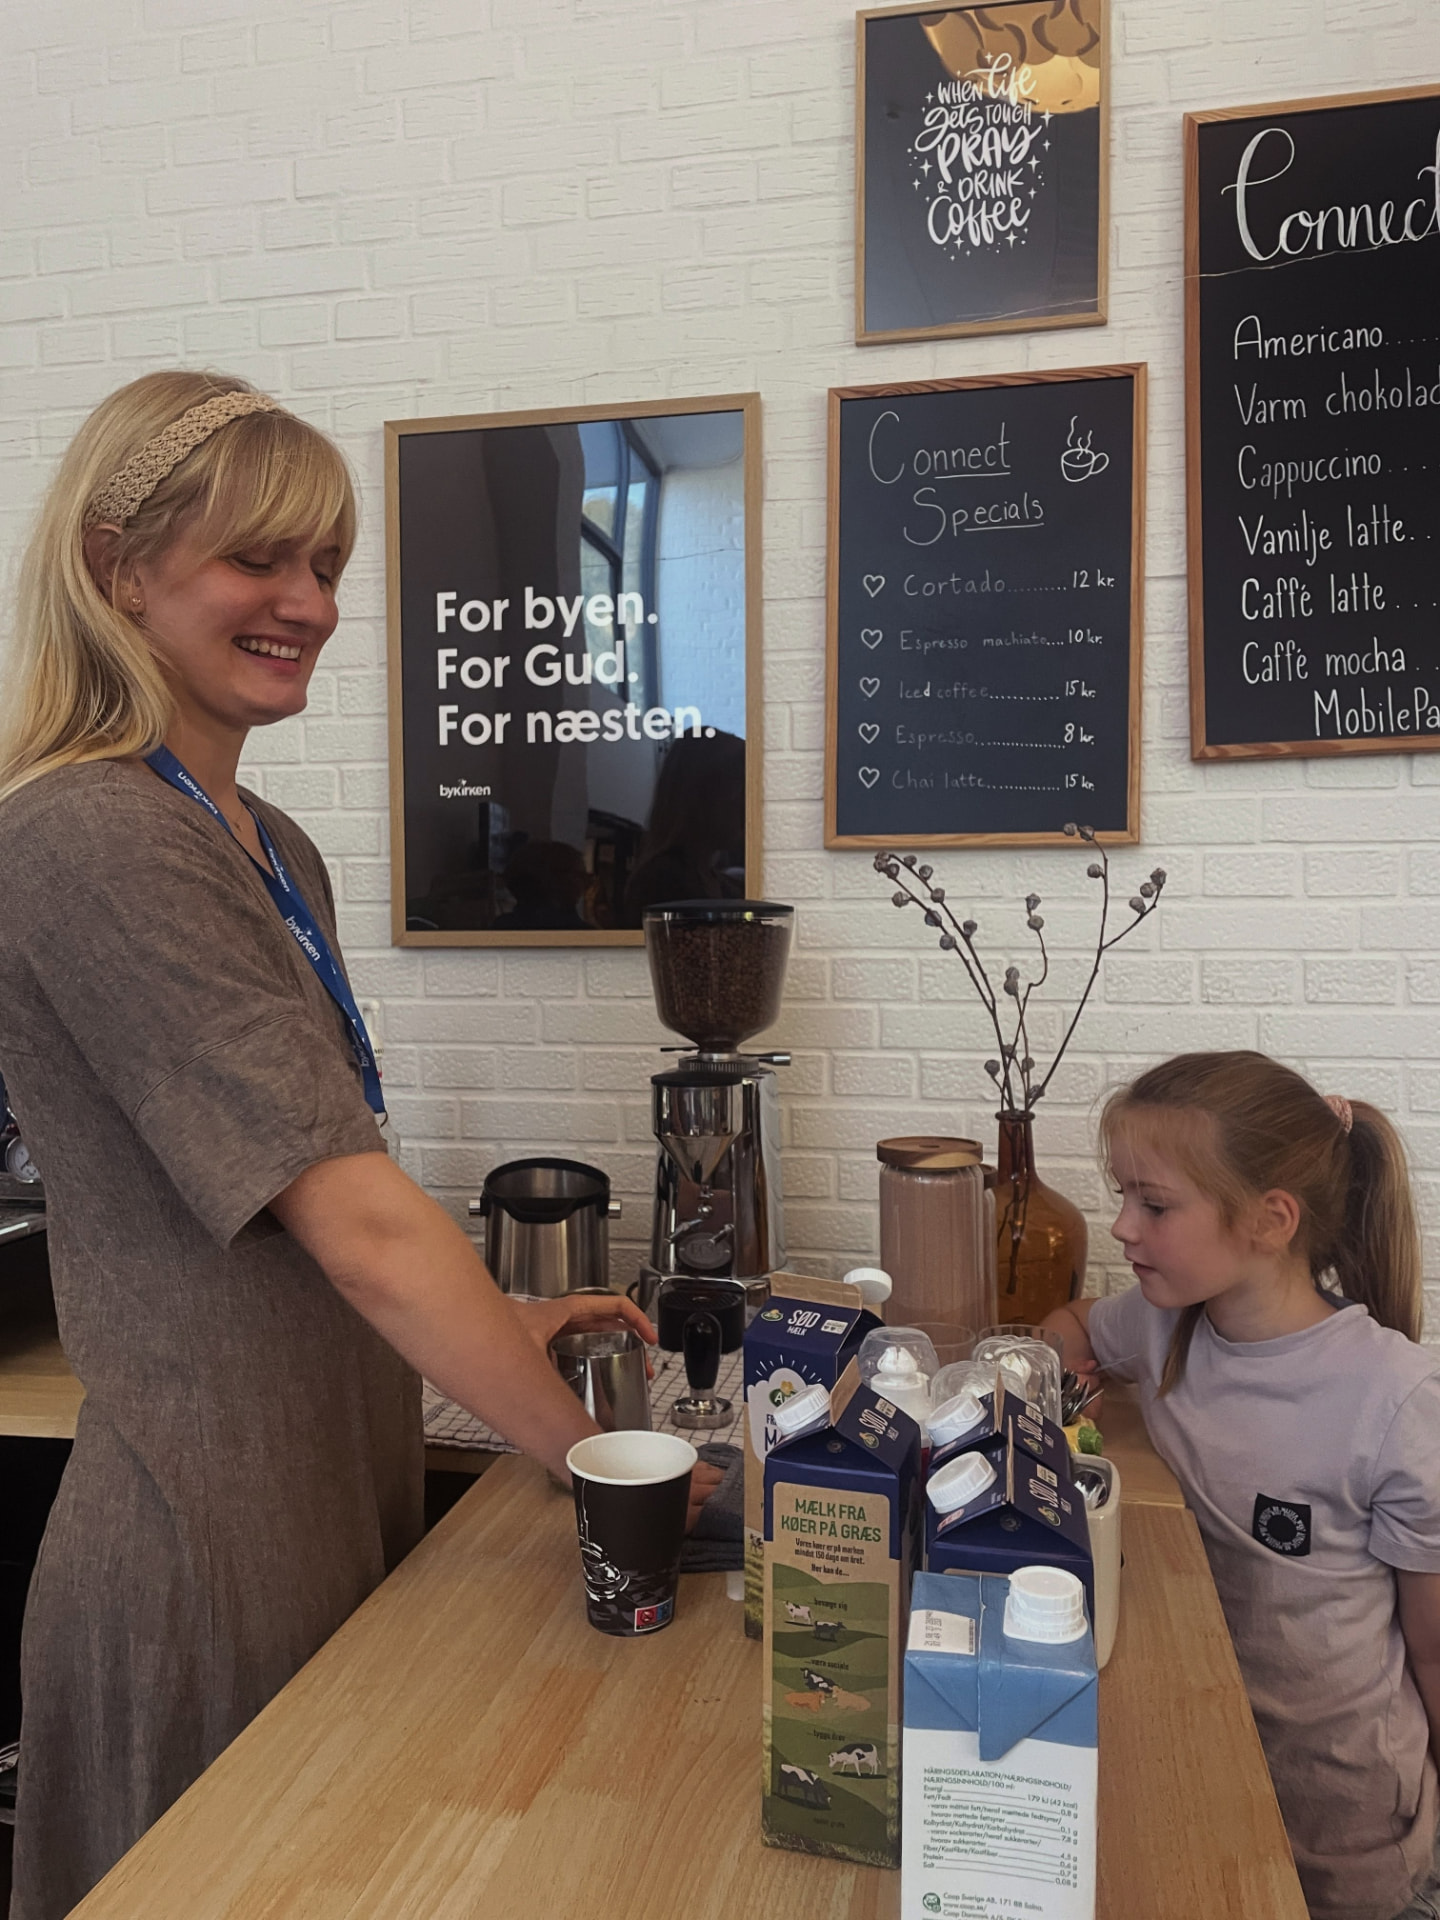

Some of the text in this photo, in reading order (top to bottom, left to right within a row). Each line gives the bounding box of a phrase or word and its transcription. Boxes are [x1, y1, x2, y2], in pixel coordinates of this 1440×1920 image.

[915, 103, 1032, 151] gets TOUGH
[937, 167, 1024, 202] & DRINK
[928, 195, 1030, 247] Coffee
[1234, 315, 1383, 360] Americano
[1234, 382, 1307, 425] Varm
[869, 410, 1011, 484] Connect
[1238, 445, 1382, 499] Cappuccino
[903, 487, 1044, 546] Specials
[1238, 509, 1333, 566] Vanilje
[1072, 570, 1091, 589] 12
[1330, 572, 1386, 614] latte
[436, 586, 659, 638] For byen.
[900, 629, 968, 655] Espresso
[1325, 636, 1406, 676] mocha
[437, 640, 639, 690] For Gud.
[1064, 680, 1079, 697] 15
[438, 702, 717, 746] For næsten.
[1314, 686, 1440, 736] MobilePa
[1063, 722, 1074, 743] 8
[892, 769, 934, 790] Chai
[1064, 773, 1079, 788] 15
[788, 1309, 821, 1328] SØD
[781, 1515, 881, 1542] KØER PÅ GRÆS
[795, 1498, 866, 1521] MÆLK FRA
[816, 1551, 825, 1559] 150
